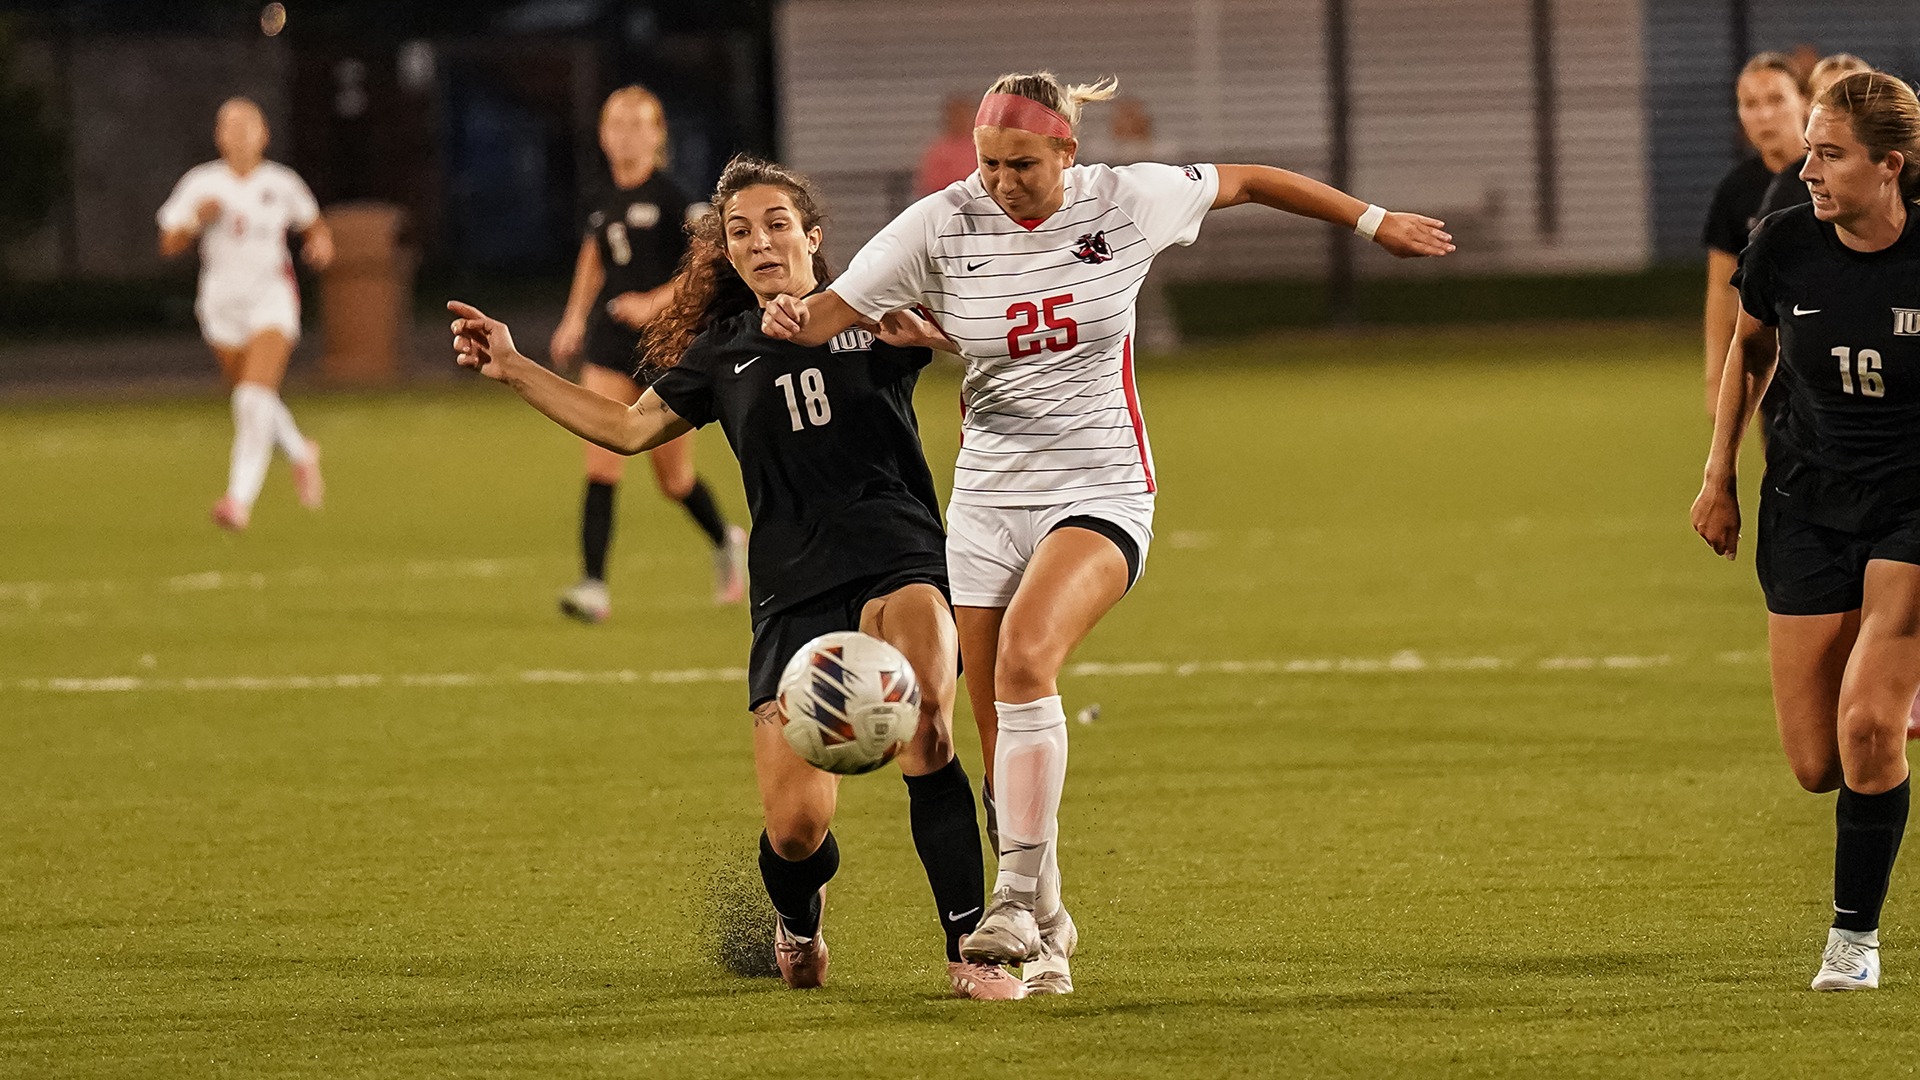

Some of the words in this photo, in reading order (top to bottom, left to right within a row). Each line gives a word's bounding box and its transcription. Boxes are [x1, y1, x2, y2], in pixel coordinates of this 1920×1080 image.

[829, 328, 875, 353] IUP
[1006, 293, 1078, 360] 25
[775, 368, 832, 432] 18
[1831, 346, 1885, 398] 16
